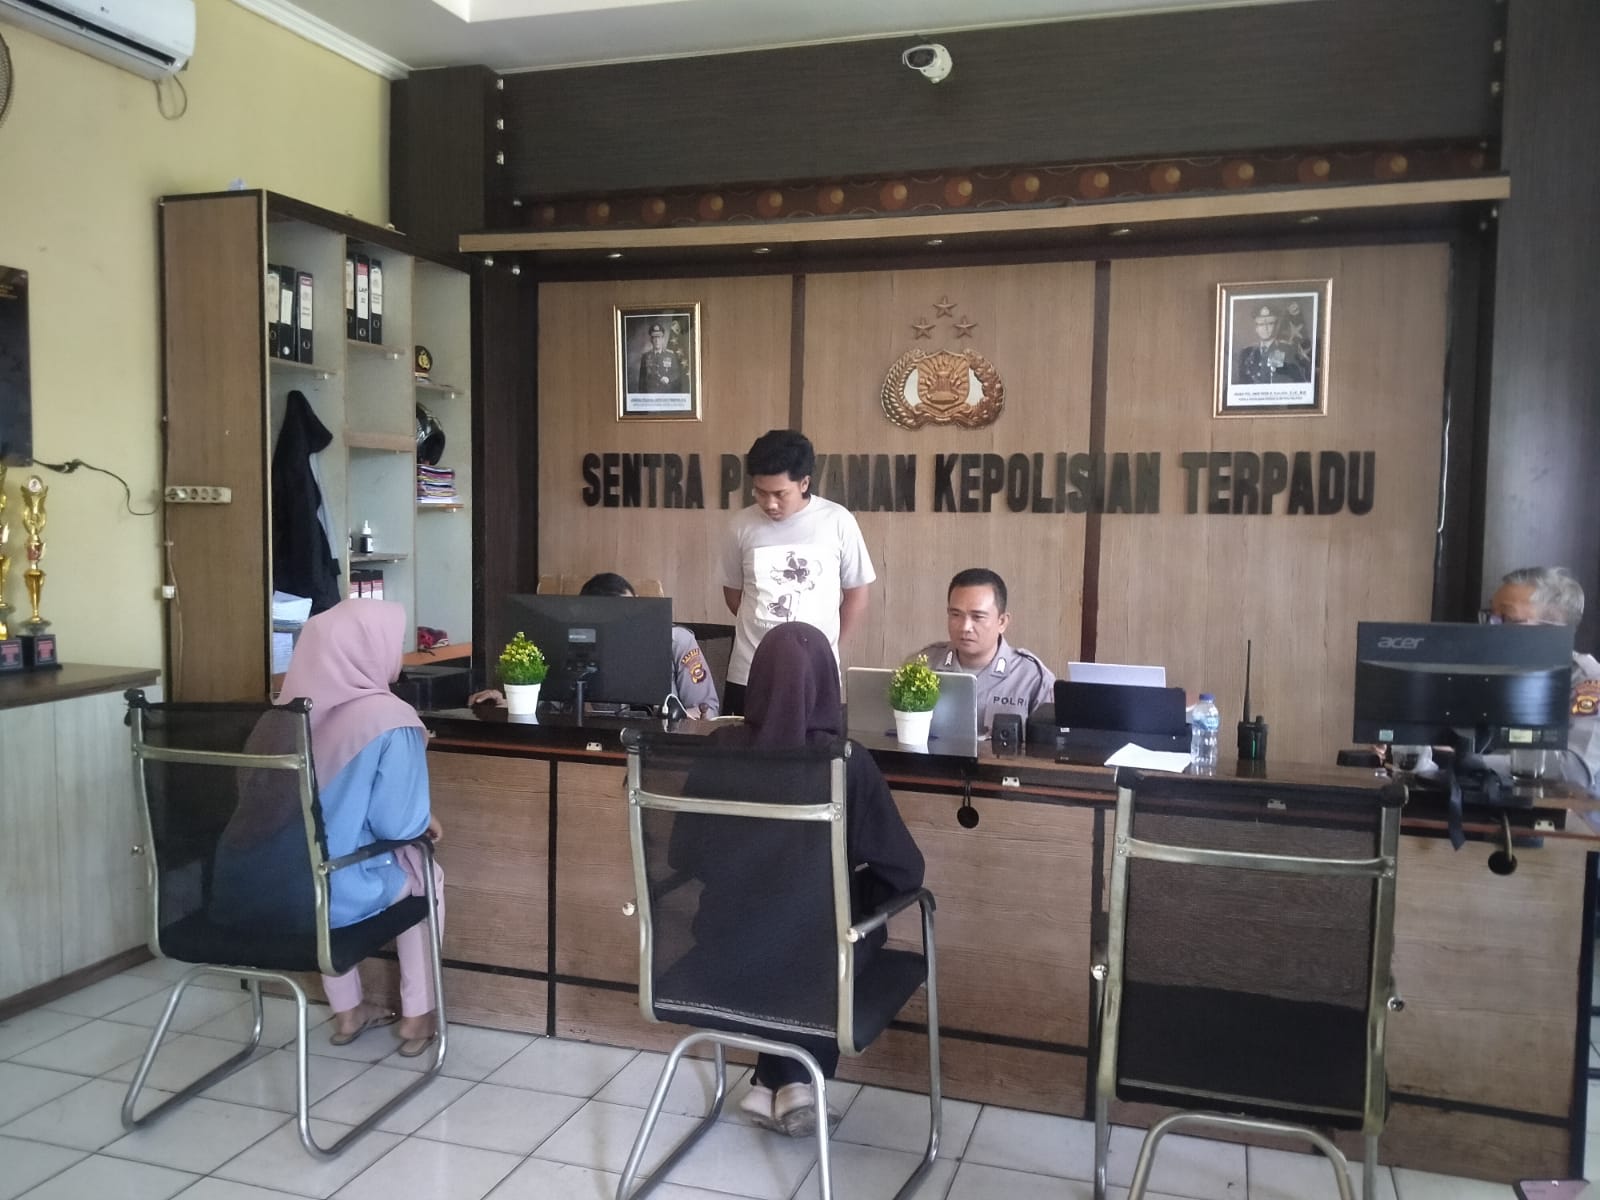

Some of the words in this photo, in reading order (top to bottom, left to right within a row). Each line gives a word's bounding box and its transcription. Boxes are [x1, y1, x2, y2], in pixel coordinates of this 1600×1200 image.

[582, 453, 704, 509] SENTRA
[934, 452, 1160, 513] KEPOLISIAN
[1181, 451, 1375, 515] TERPADU
[1377, 636, 1424, 650] acer
